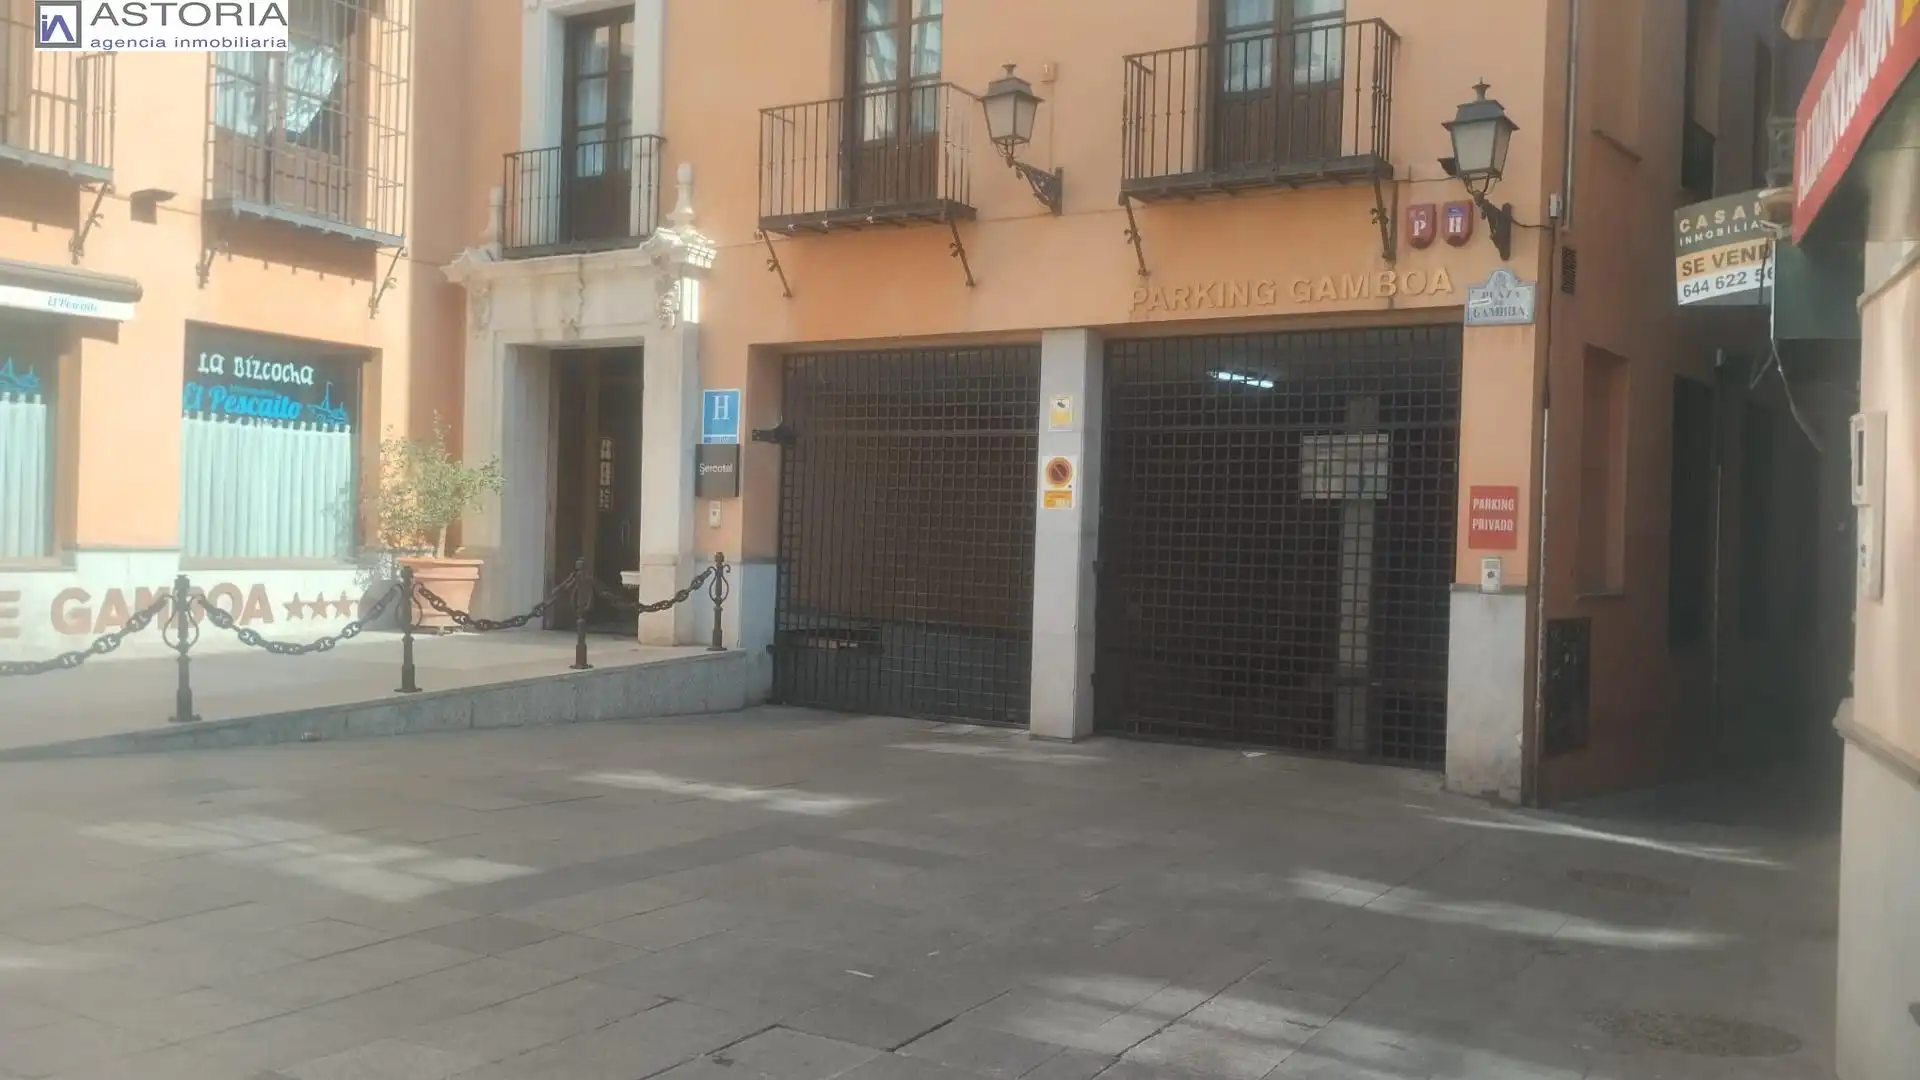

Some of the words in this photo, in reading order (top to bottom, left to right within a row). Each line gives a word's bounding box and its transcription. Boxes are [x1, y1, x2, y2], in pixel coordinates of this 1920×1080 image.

[1682, 257, 1705, 277] SE
[1131, 279, 1277, 312] PARKING
[1292, 264, 1455, 302] GAMBOA
[1683, 280, 1709, 297] 644
[1715, 271, 1747, 290] 622
[712, 395, 730, 420] H
[1472, 497, 1515, 511] PARKING
[1472, 518, 1514, 531] PRIVADO
